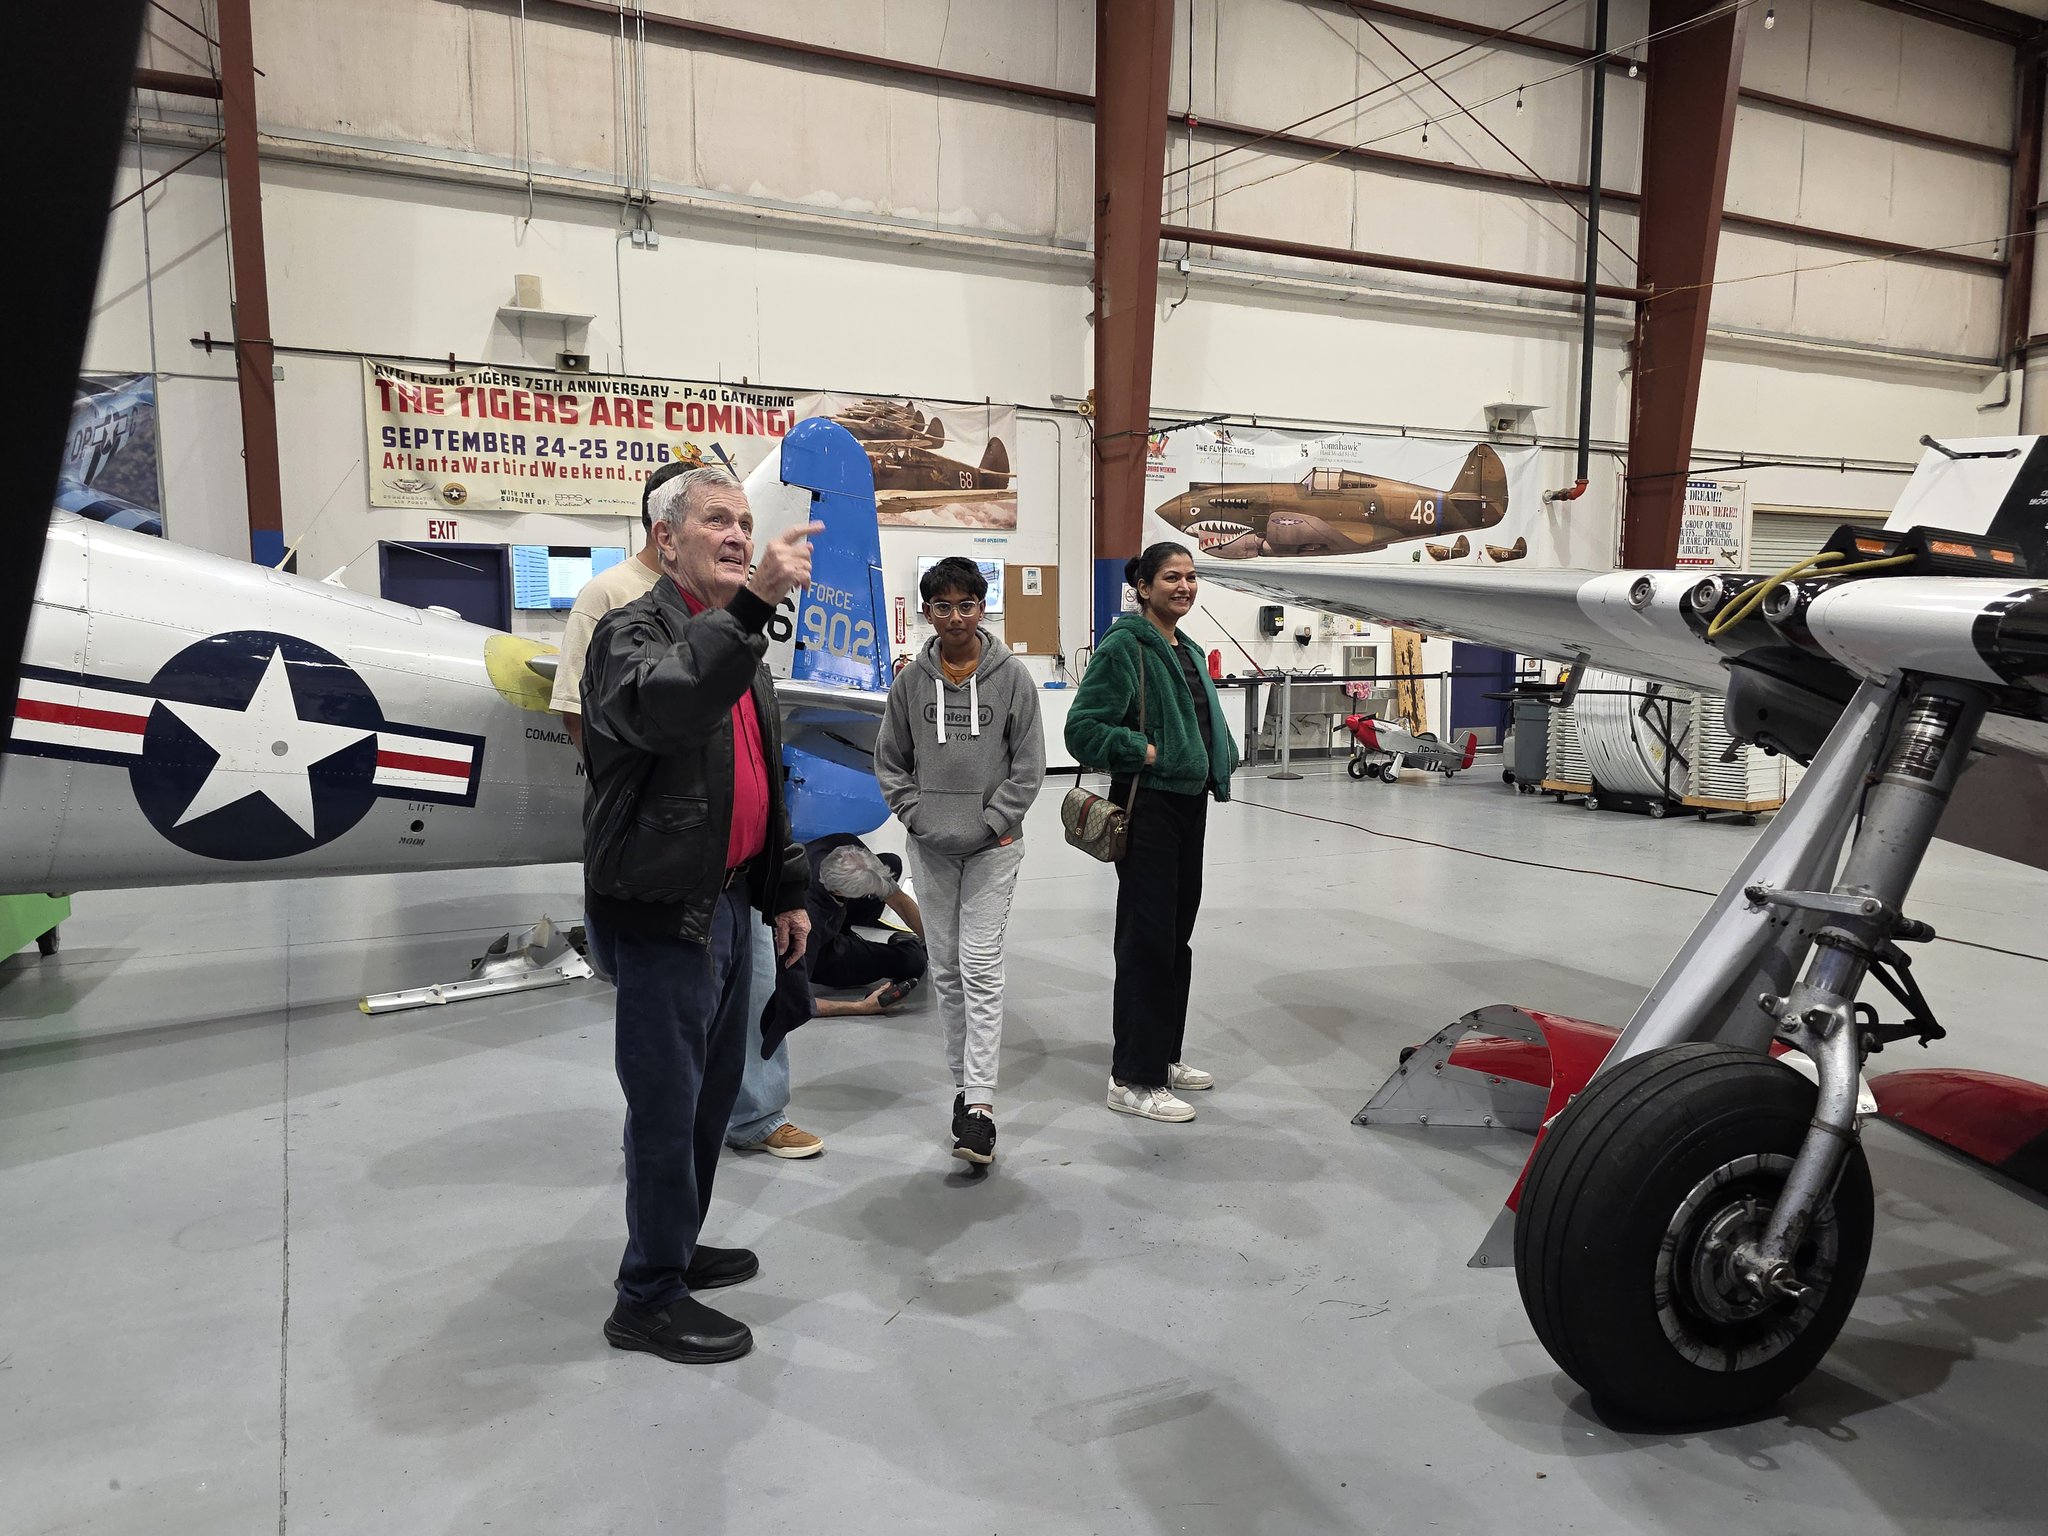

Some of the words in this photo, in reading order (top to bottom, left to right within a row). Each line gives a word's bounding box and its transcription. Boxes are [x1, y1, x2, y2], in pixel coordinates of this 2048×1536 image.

[411, 370, 465, 386] FLYING
[469, 372, 521, 387] TIGERS
[525, 377, 563, 392] 75TH
[567, 380, 669, 397] ANNIVERSARY
[684, 388, 716, 400] P-40
[721, 390, 795, 407] GATHERING
[375, 379, 444, 415] THE
[455, 386, 579, 425] TIGERS
[589, 396, 653, 429] ARE
[665, 401, 796, 438] COMING!
[382, 426, 526, 456] SEPTEMBER
[536, 436, 608, 459] 24-25
[616, 440, 670, 463] 2016
[1209, 445, 1233, 454] FLYNG
[383, 452, 652, 482] AtlantaWarbirdWeekend.co
[959, 471, 973, 489] 68
[501, 496, 537, 505] SUPPORT
[1690, 490, 1722, 502] DREAM!!
[1410, 500, 1435, 524] 48
[1689, 505, 1710, 516] WING
[1713, 506, 1738, 518] HERE!!
[428, 520, 458, 540] EXIT
[1685, 520, 1704, 529] GROUP
[1705, 521, 1714, 529] OF
[1715, 522, 1733, 531] WORLD
[807, 581, 854, 611] FORCE
[930, 706, 987, 723] Nnteno
[409, 803, 435, 813] LIFT
